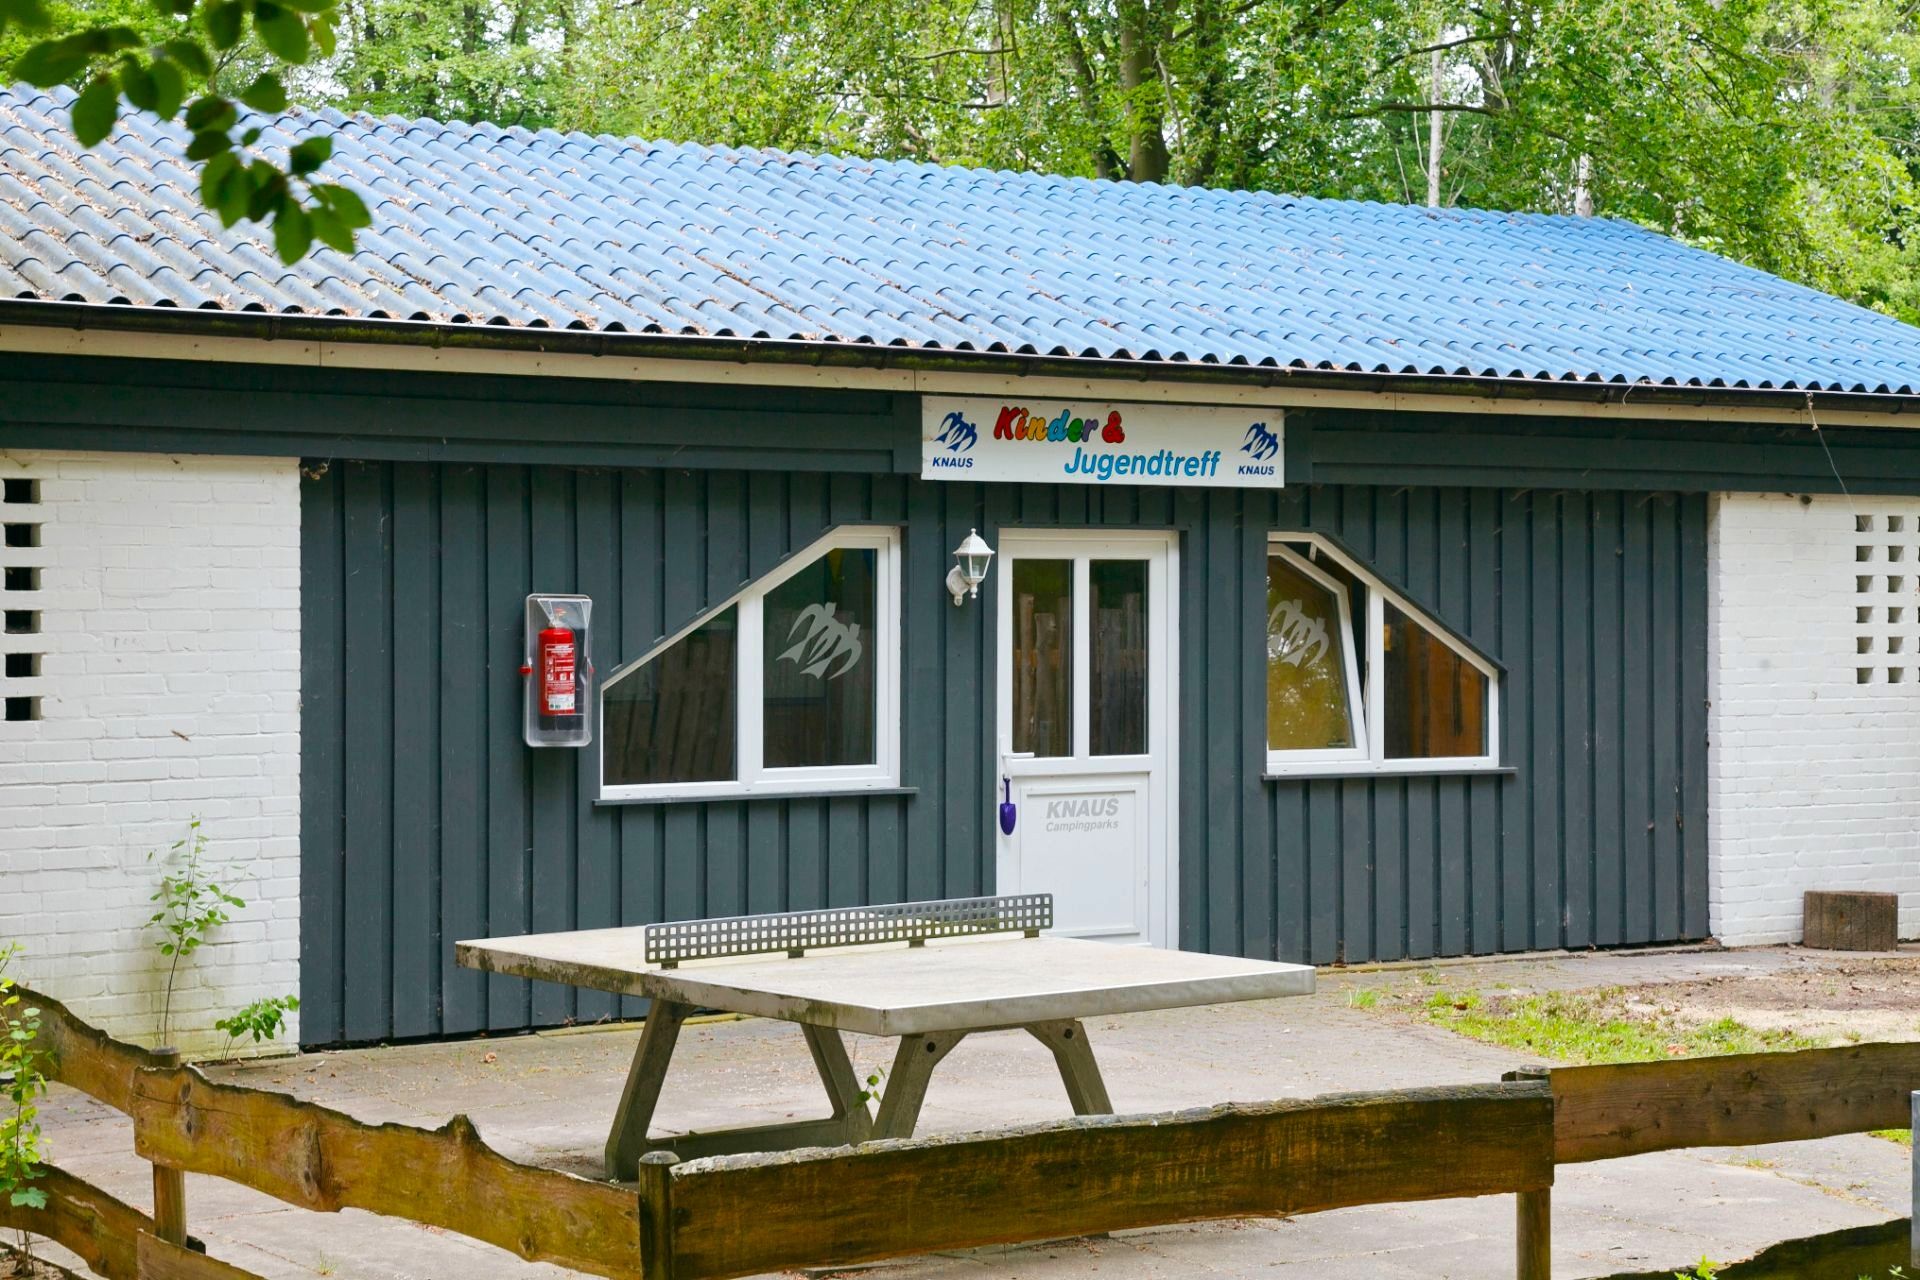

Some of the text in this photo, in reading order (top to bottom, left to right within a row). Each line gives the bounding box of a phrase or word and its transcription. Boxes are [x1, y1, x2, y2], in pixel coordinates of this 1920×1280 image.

[993, 406, 1126, 443] Kinder &
[932, 456, 974, 469] KNAUS
[1064, 447, 1221, 481] Jugendtreff
[1237, 464, 1275, 476] KNAUS
[1046, 798, 1120, 819] KNAUS
[1046, 819, 1119, 833] Campingparks
